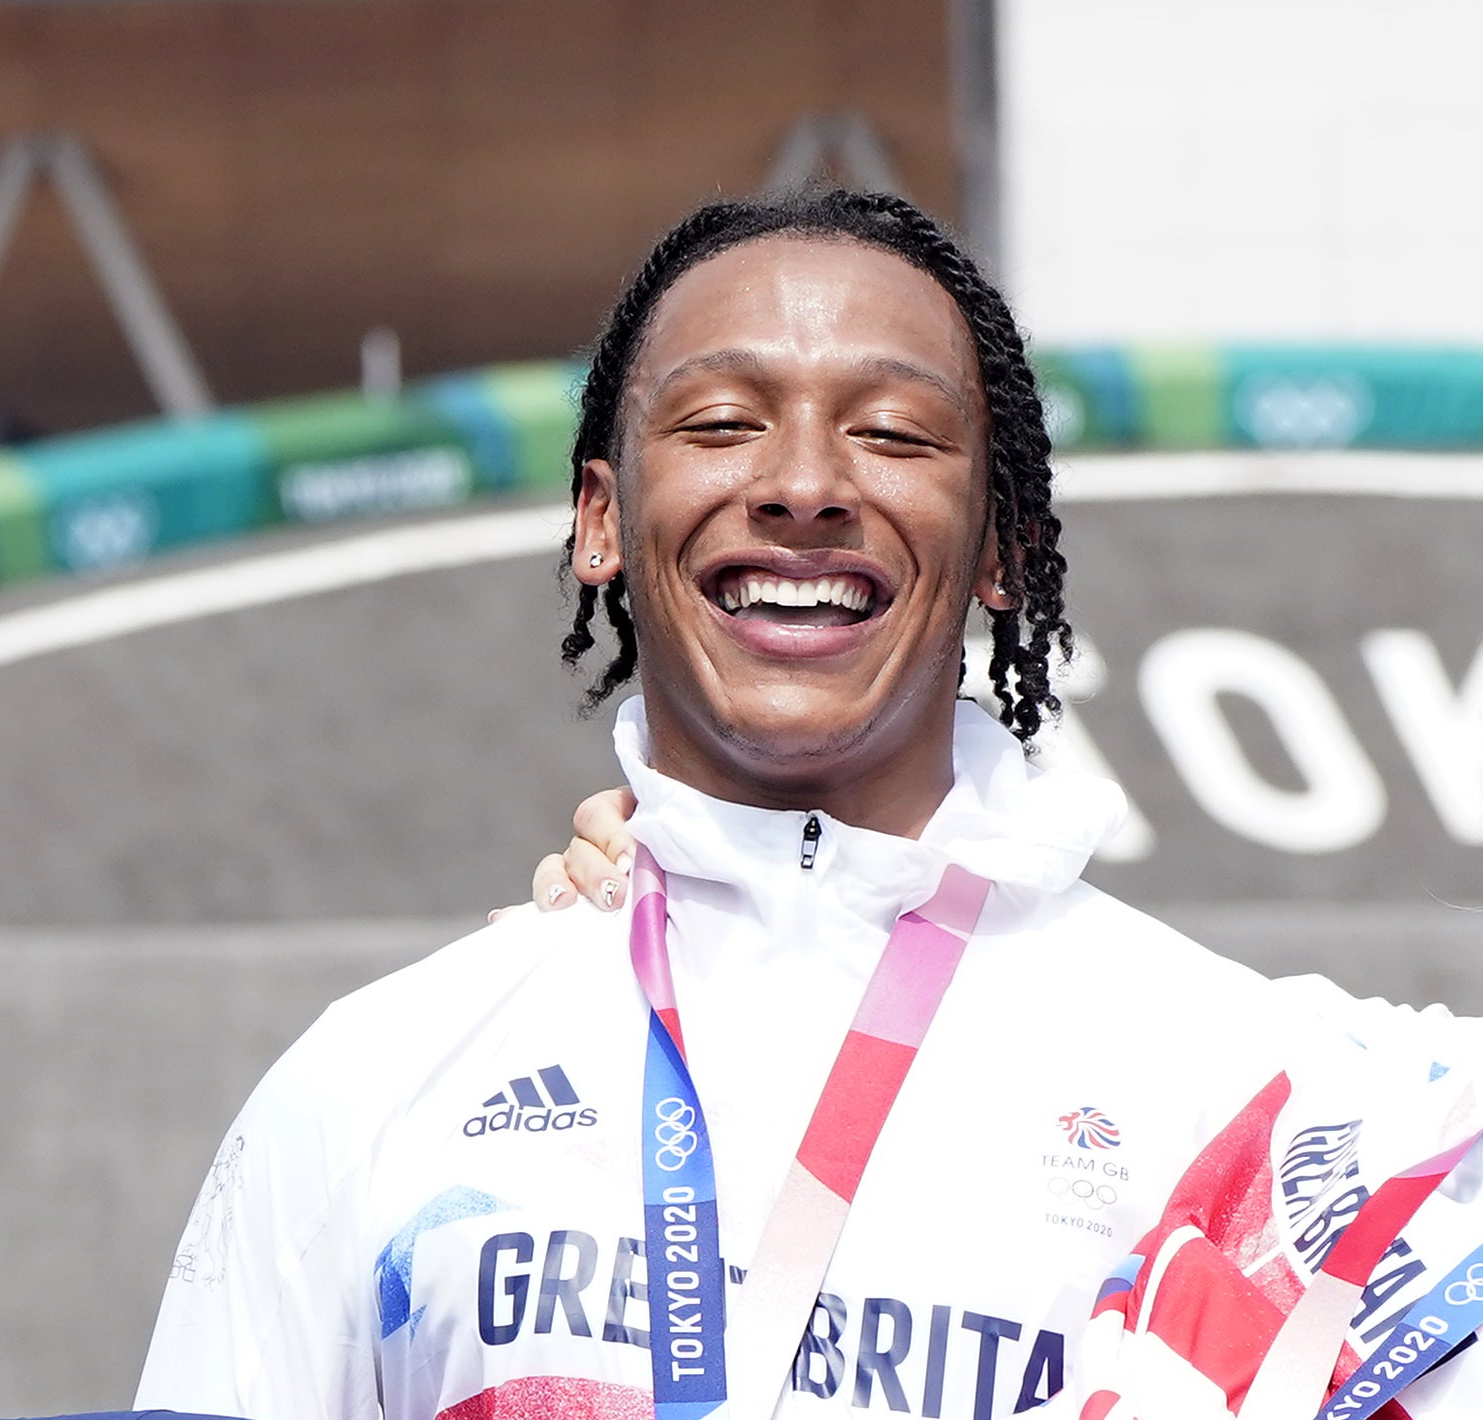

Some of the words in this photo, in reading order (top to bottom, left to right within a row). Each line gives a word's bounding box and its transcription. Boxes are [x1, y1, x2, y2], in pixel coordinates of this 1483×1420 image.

[462, 1105, 599, 1138] adidas
[1041, 1154, 1096, 1173] TEAM
[1102, 1161, 1130, 1182] GB
[661, 1185, 699, 1264] 2020
[1044, 1213, 1085, 1228] TOKYO
[1086, 1220, 1113, 1238] 2020
[477, 1229, 748, 1350] GRE
[663, 1270, 706, 1383] TOKYO
[1373, 1315, 1449, 1386] 2020
